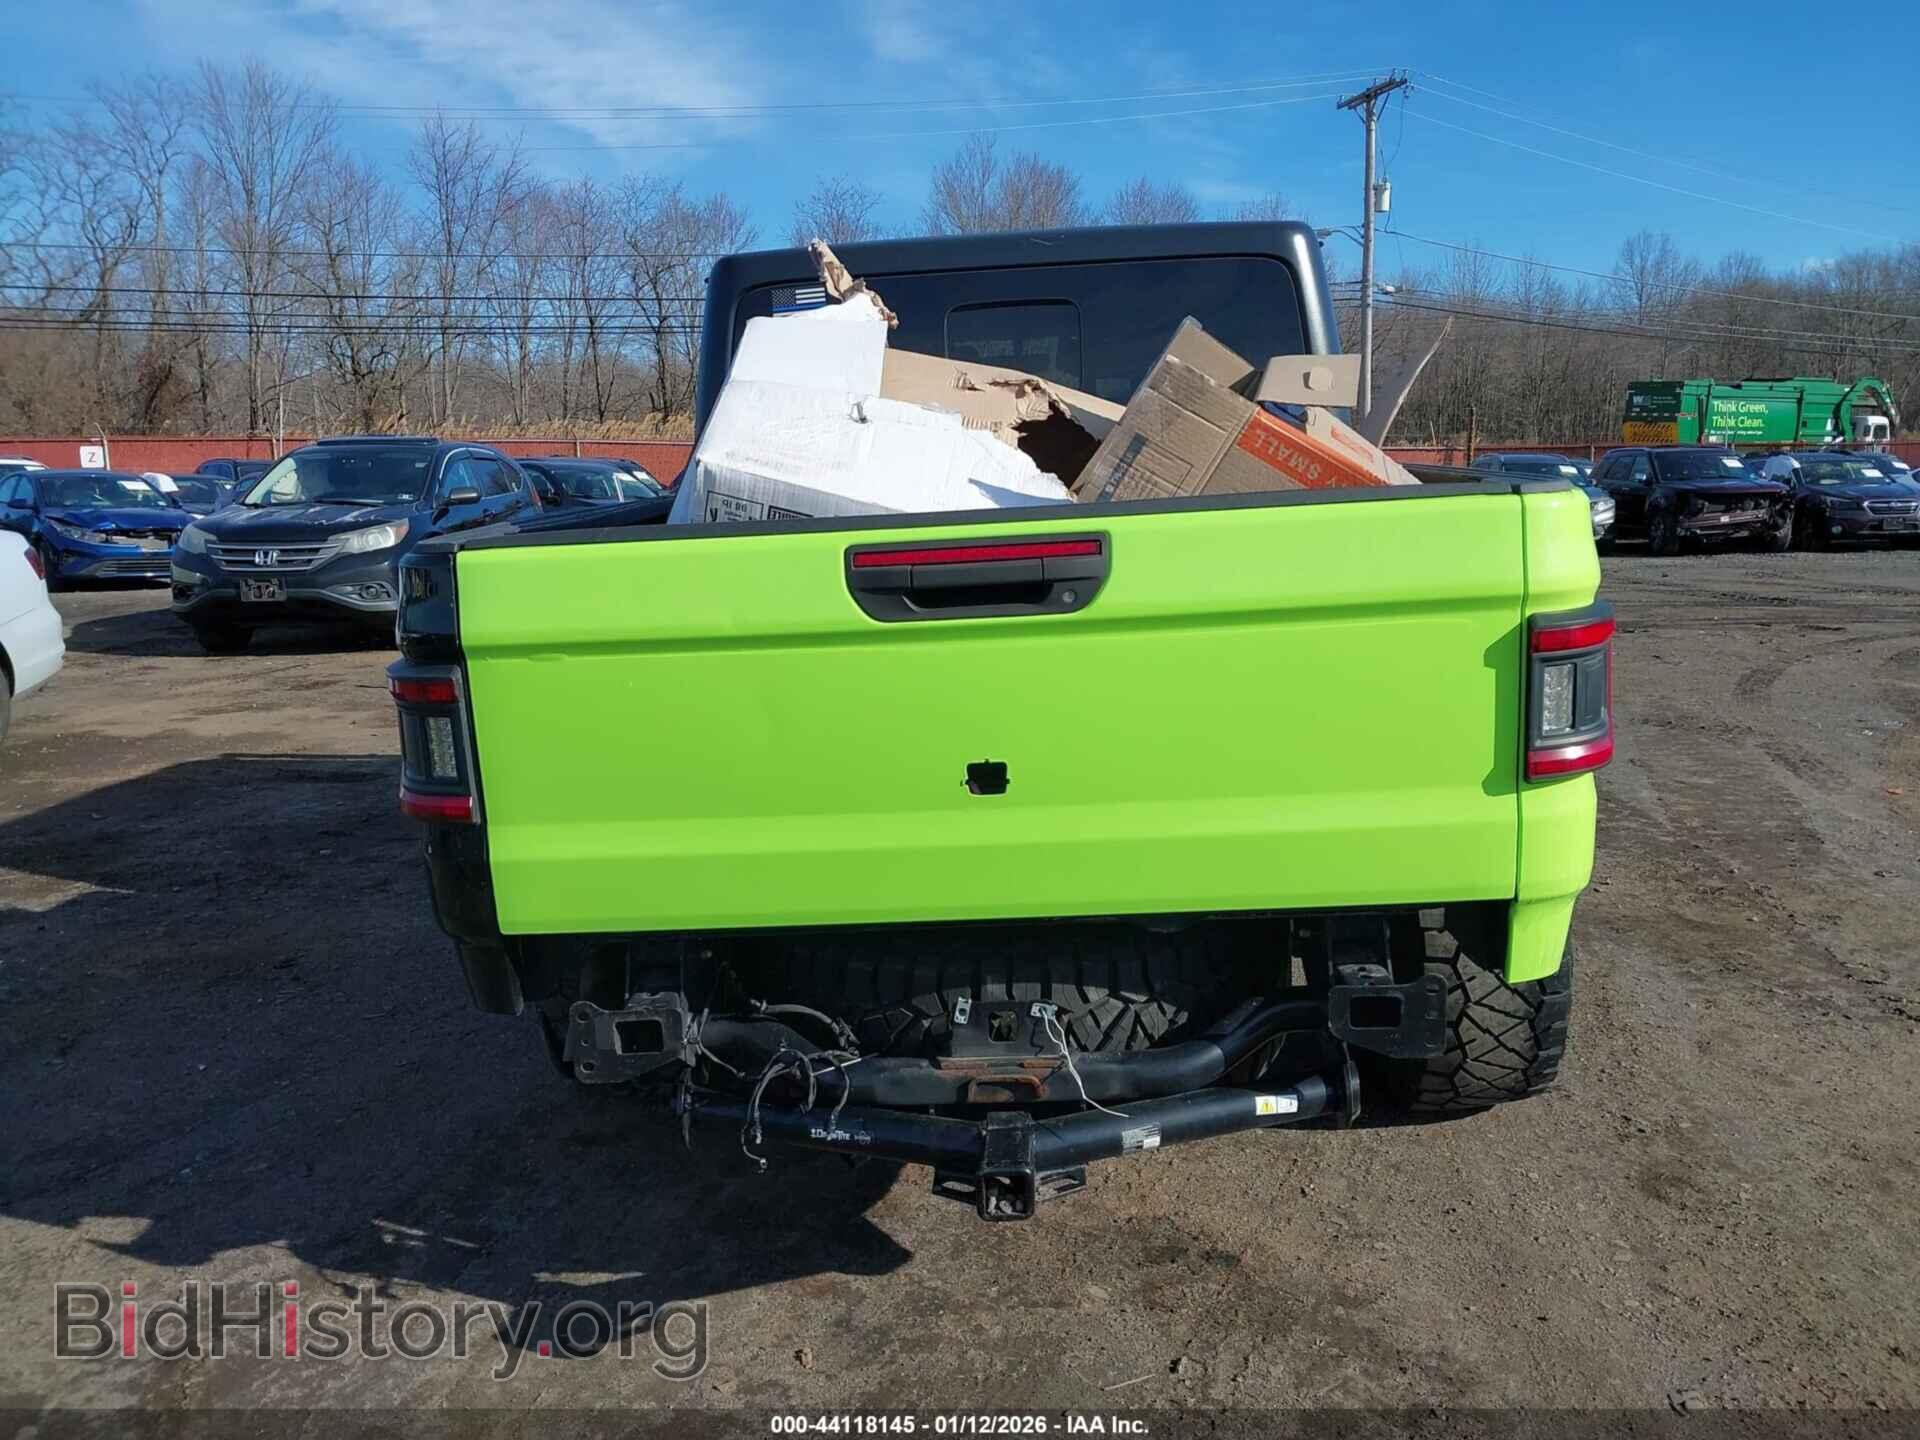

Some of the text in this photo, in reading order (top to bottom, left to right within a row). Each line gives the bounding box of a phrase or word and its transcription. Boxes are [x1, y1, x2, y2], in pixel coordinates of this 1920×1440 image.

[1712, 400, 1769, 415] Think Green,
[1711, 416, 1765, 427] Think Clean.
[87, 452, 97, 463] Z
[1256, 430, 1321, 480] SMALL
